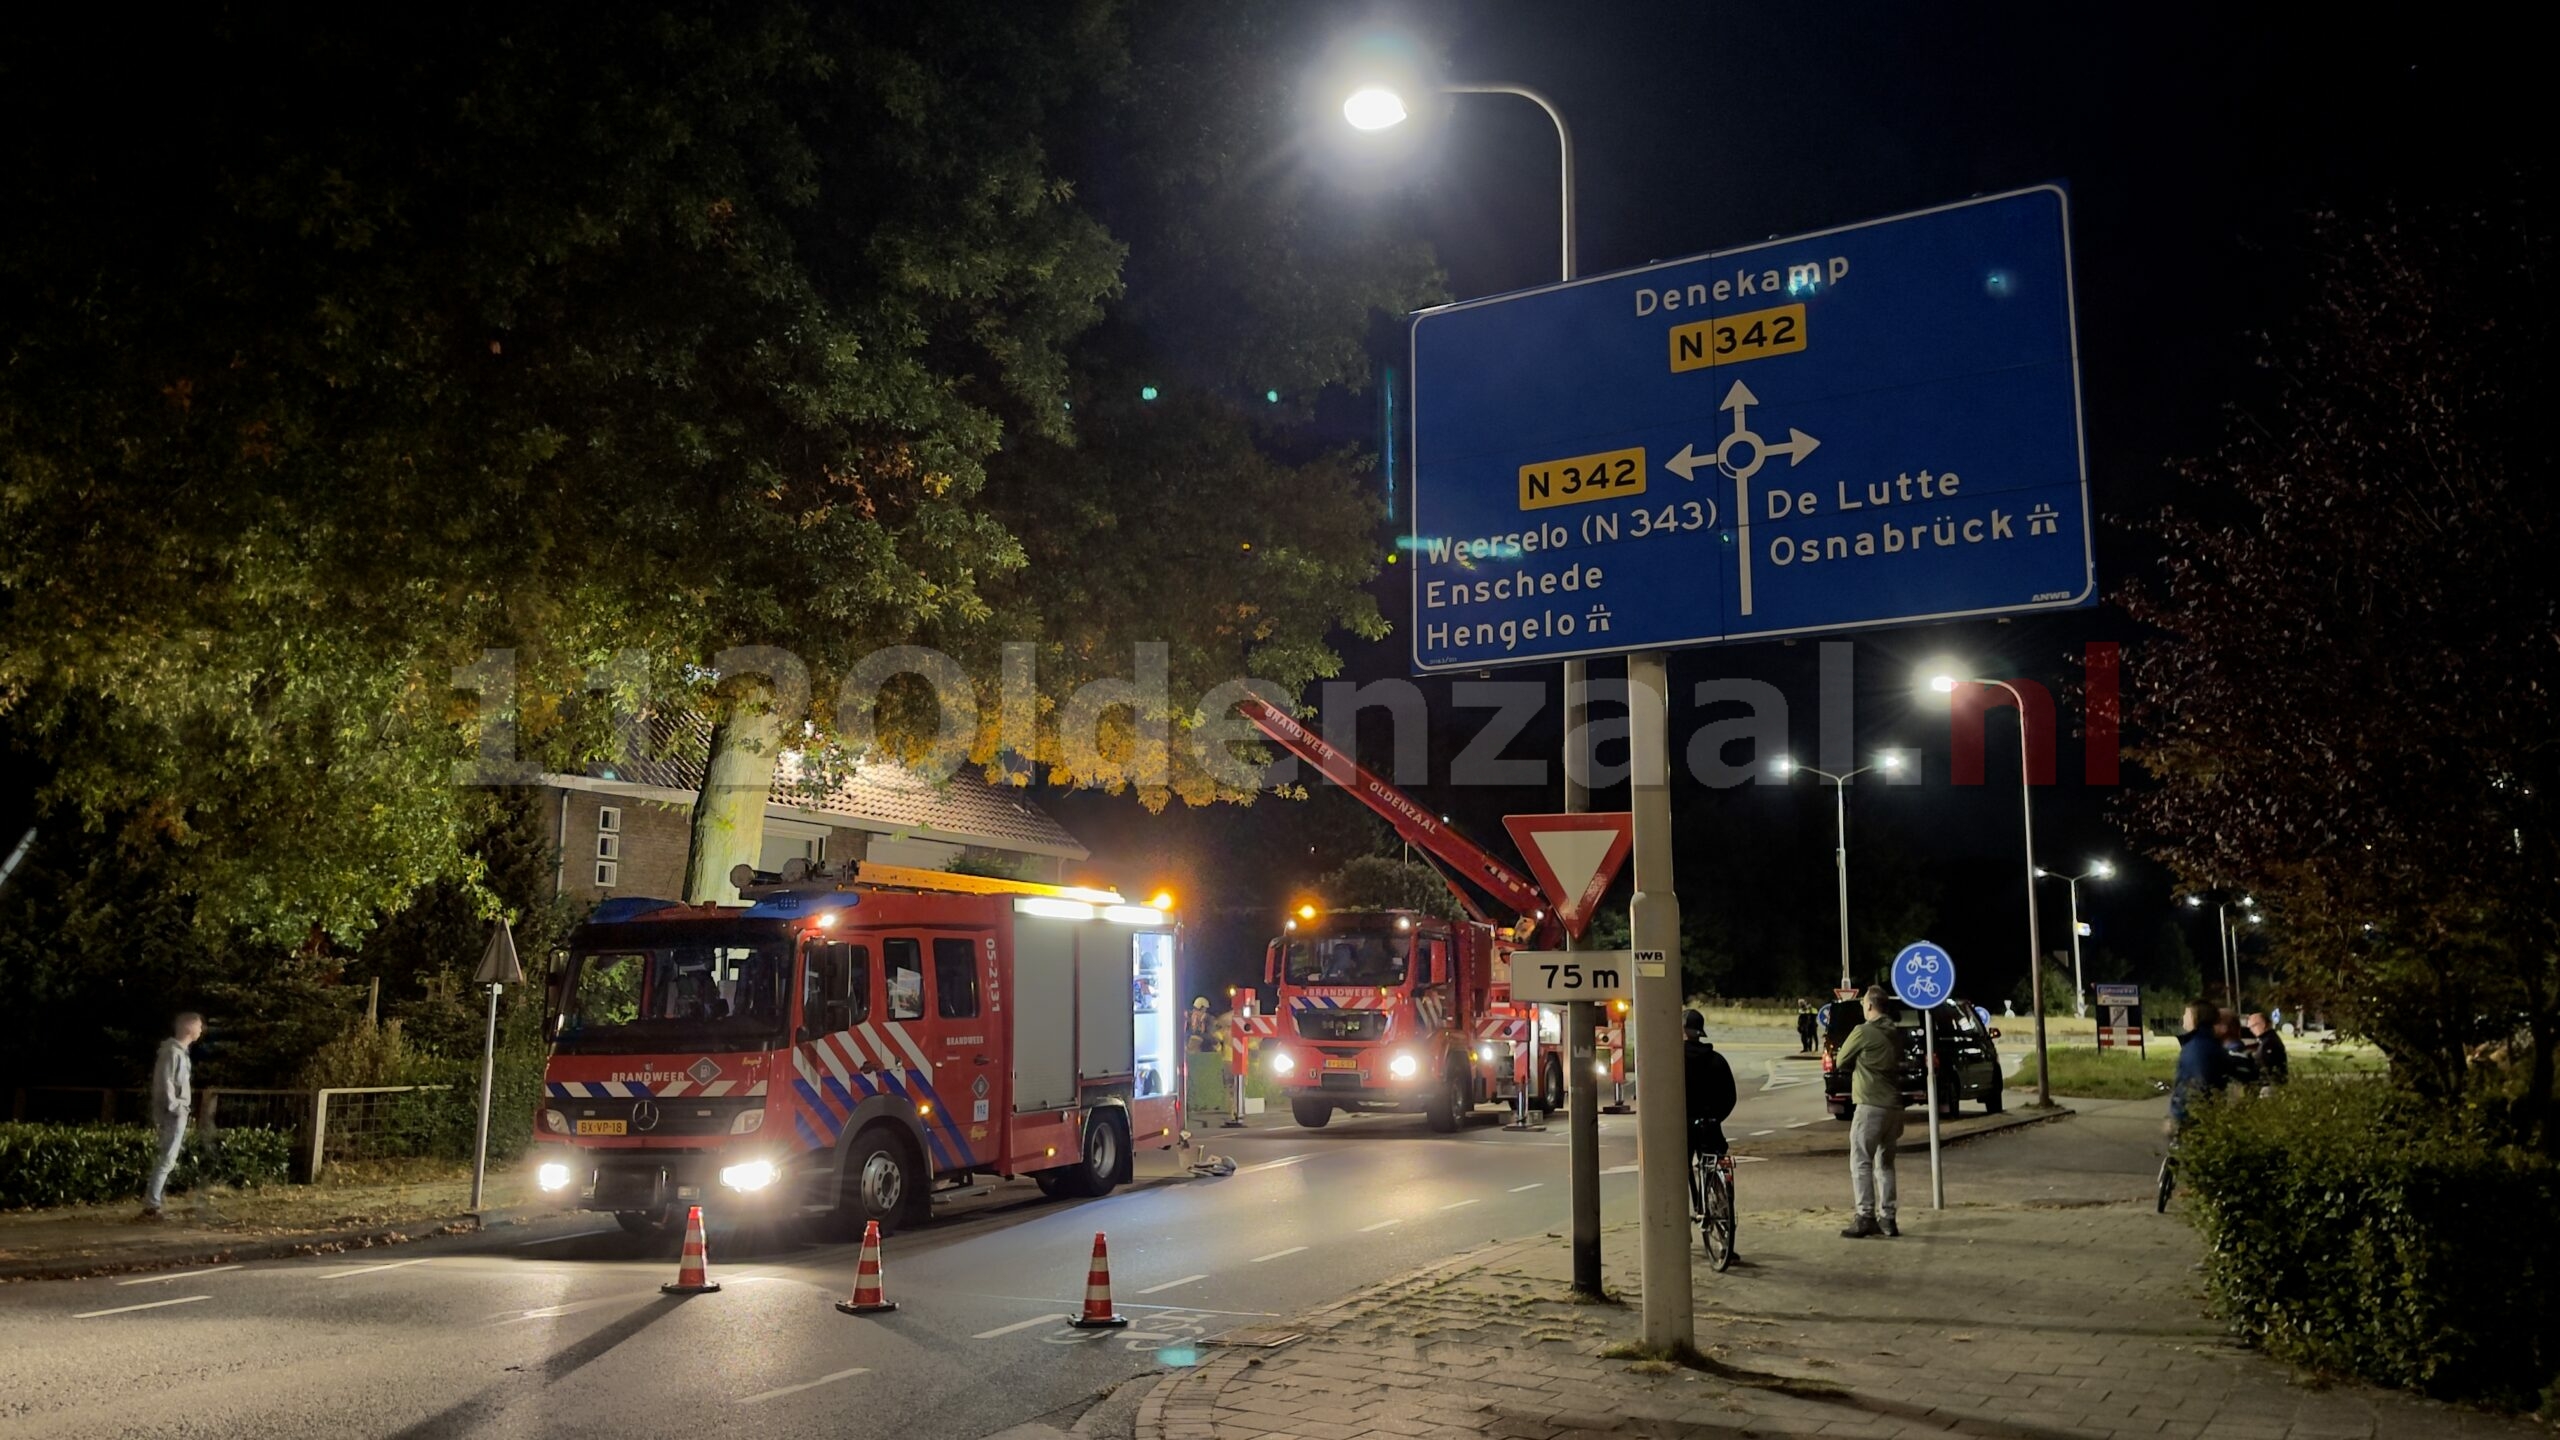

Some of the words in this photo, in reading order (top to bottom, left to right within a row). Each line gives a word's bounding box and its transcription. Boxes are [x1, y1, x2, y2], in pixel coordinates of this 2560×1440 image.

[1635, 256, 1849, 318] Denekamp
[1679, 331, 1703, 362] N
[1715, 315, 1797, 355] 342
[1528, 471, 1550, 500] N
[1561, 458, 1637, 495] 342
[1767, 489, 1818, 520] De
[1838, 469, 1961, 511] Lutte
[1427, 521, 1569, 565] Weerselo
[1581, 512, 1619, 545] (N
[1629, 497, 1718, 538] 343)
[1769, 508, 2015, 567] Osnabrück
[1426, 562, 1604, 609] Enschede
[2031, 590, 2072, 602] ANWB
[1426, 609, 1576, 651] Hengelo
[1264, 706, 1335, 760] BRANDWEER
[1369, 781, 1437, 835] OLDENZAAL
[985, 937, 1001, 1012] 05-2131
[1539, 964, 1583, 989] 75
[1592, 969, 1620, 989] m
[1634, 951, 1663, 961] NWB
[1308, 988, 1375, 997] BRANDWEER
[611, 1071, 685, 1083] BRANDWEER
[579, 1121, 623, 1135] BX-VP-18
